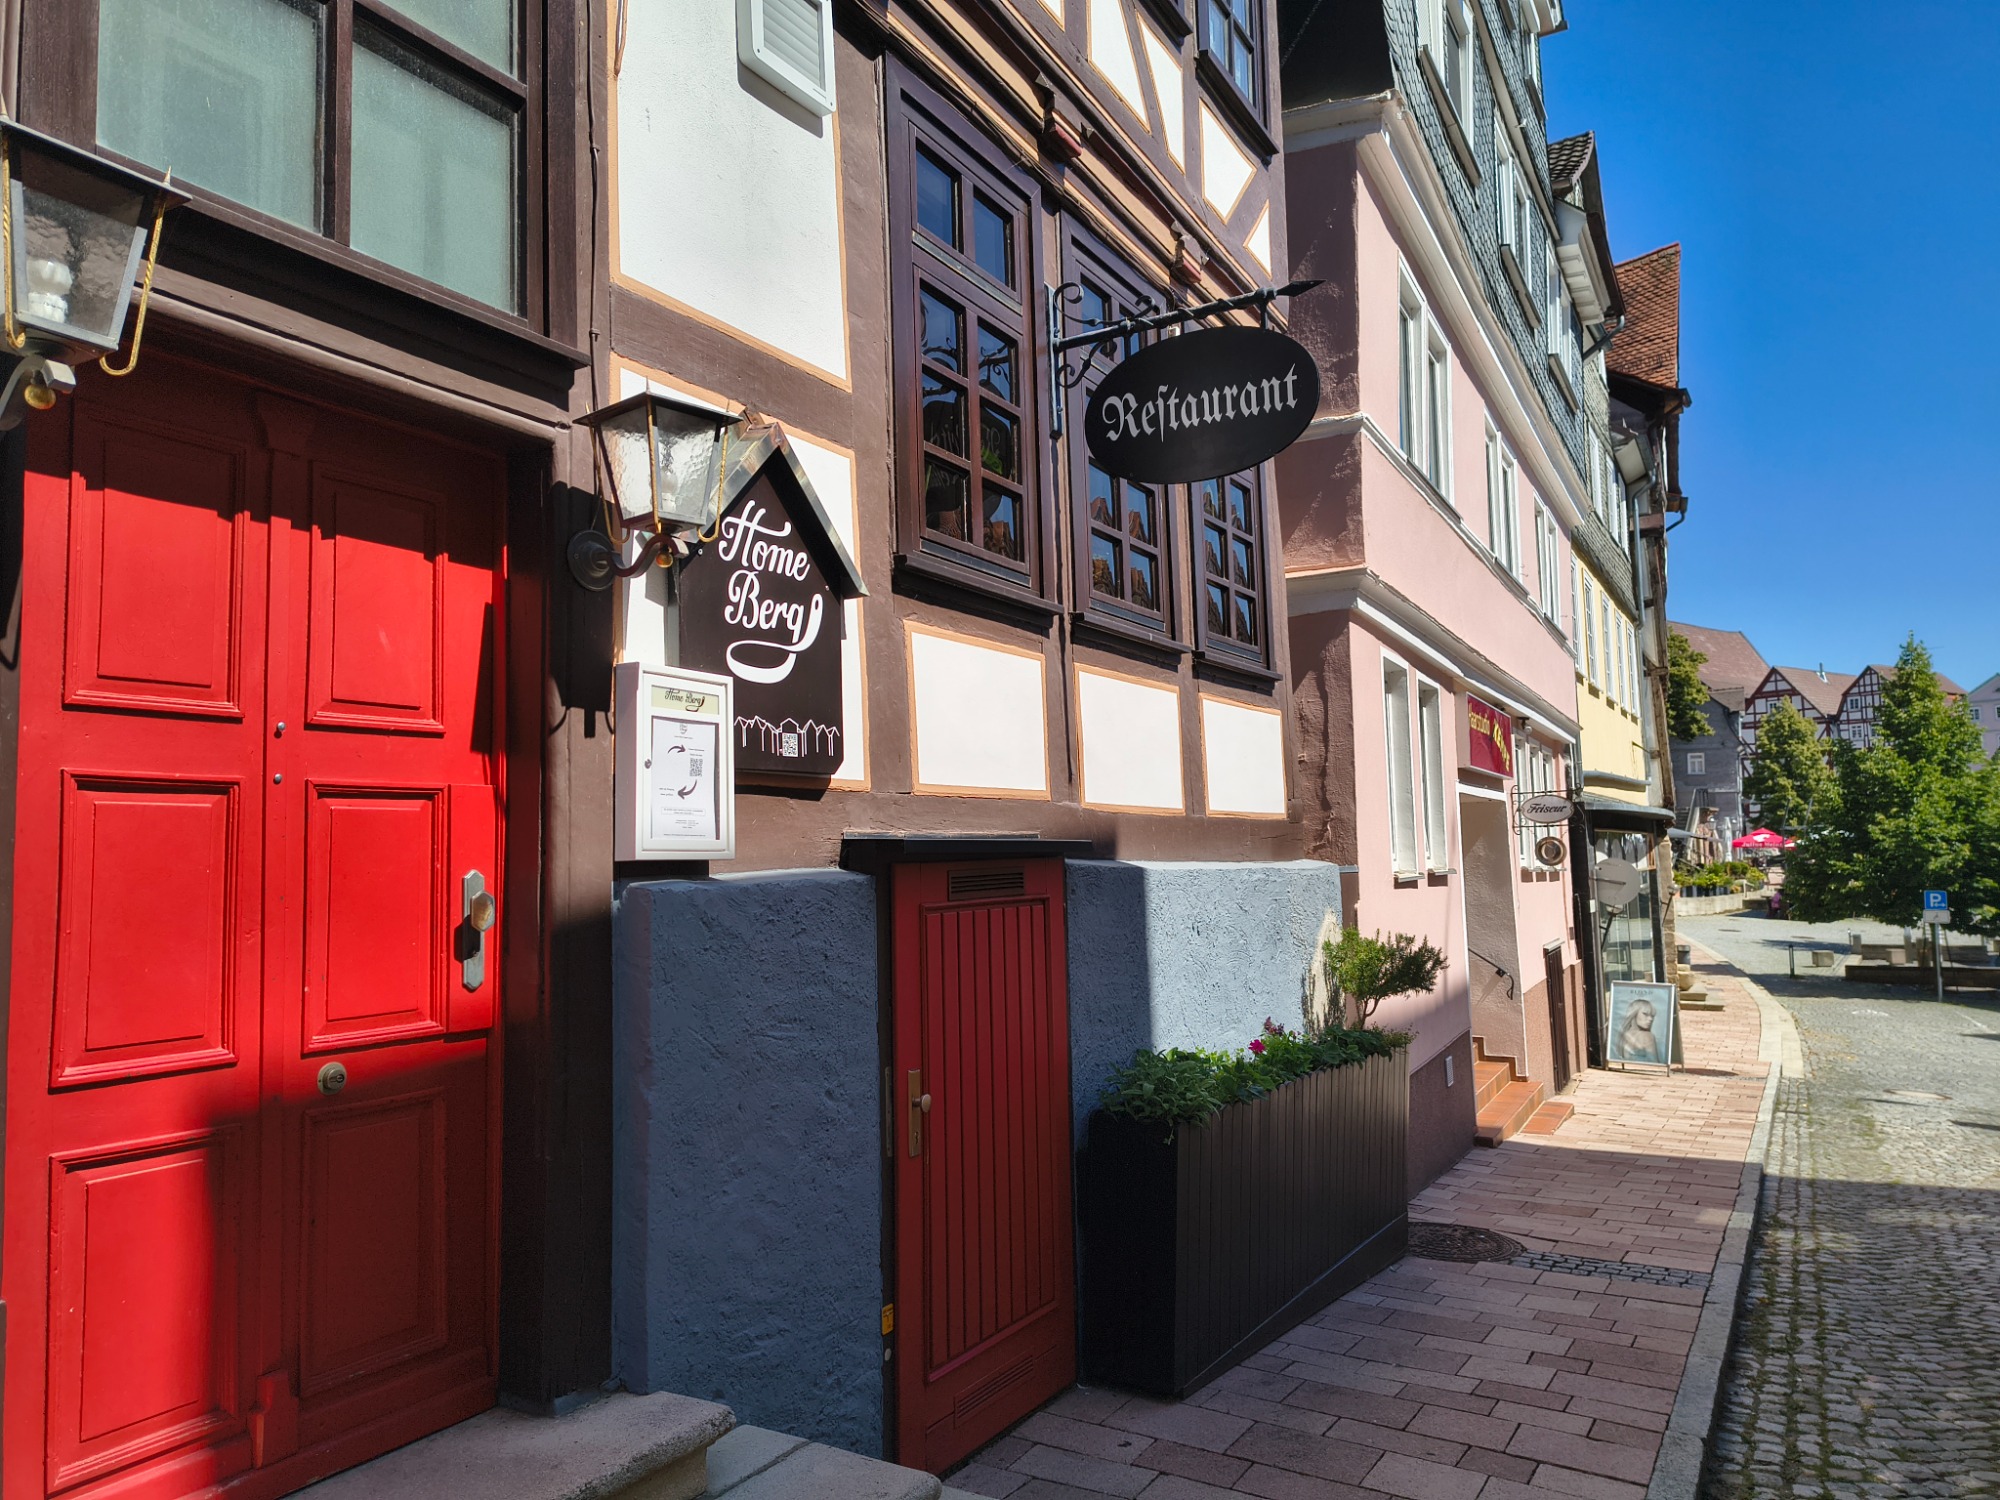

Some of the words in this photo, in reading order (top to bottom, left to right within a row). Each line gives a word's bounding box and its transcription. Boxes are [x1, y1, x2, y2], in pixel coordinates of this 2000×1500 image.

[718, 500, 811, 581] Home
[724, 569, 823, 684] Berg
[665, 688, 684, 702] Home
[685, 692, 705, 712] Berg
[1527, 803, 1567, 813] Friseur
[1930, 893, 1941, 907] P
